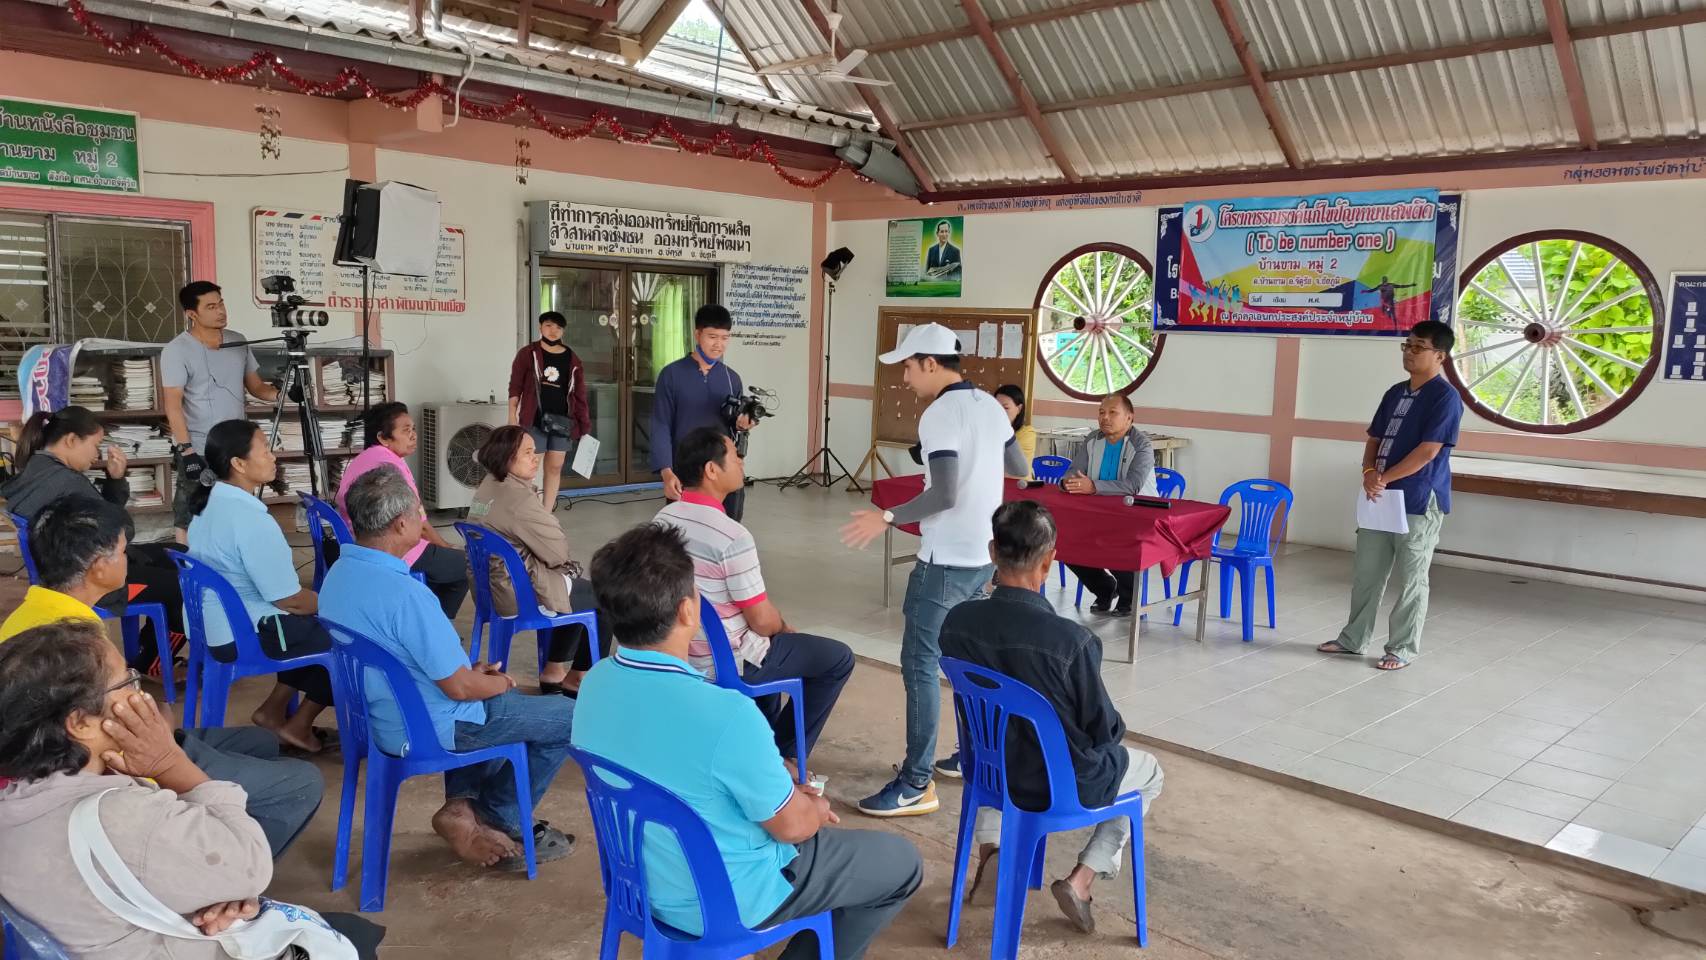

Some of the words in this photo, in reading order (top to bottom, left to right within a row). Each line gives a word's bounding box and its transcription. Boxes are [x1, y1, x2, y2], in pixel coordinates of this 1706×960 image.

[73, 147, 98, 172] หมู่
[105, 152, 118, 167] 2
[1563, 158, 1706, 182] กลุ่มออมทรัพย์หมู่บ้
[550, 202, 751, 236] ที่ทำการกลุ่มออมทรัพย์เพื่อการผลิต
[1218, 198, 1434, 228] โครงการรณรงค์แก้ไขปัญหายาเสพติด
[654, 231, 751, 252] ออมทรัพย์พัฒนา
[1258, 233, 1273, 250] To
[1278, 232, 1294, 250] be
[1299, 230, 1351, 250] number
[1356, 234, 1382, 249] one
[1258, 256, 1301, 271] บ้านขาม
[1307, 256, 1324, 273] หมู่
[1329, 258, 1337, 269] 2
[1220, 312, 1230, 321] ณ
[1232, 310, 1373, 327] ศาลาเอนกประสงค์ประจำหมู่บ้าน
